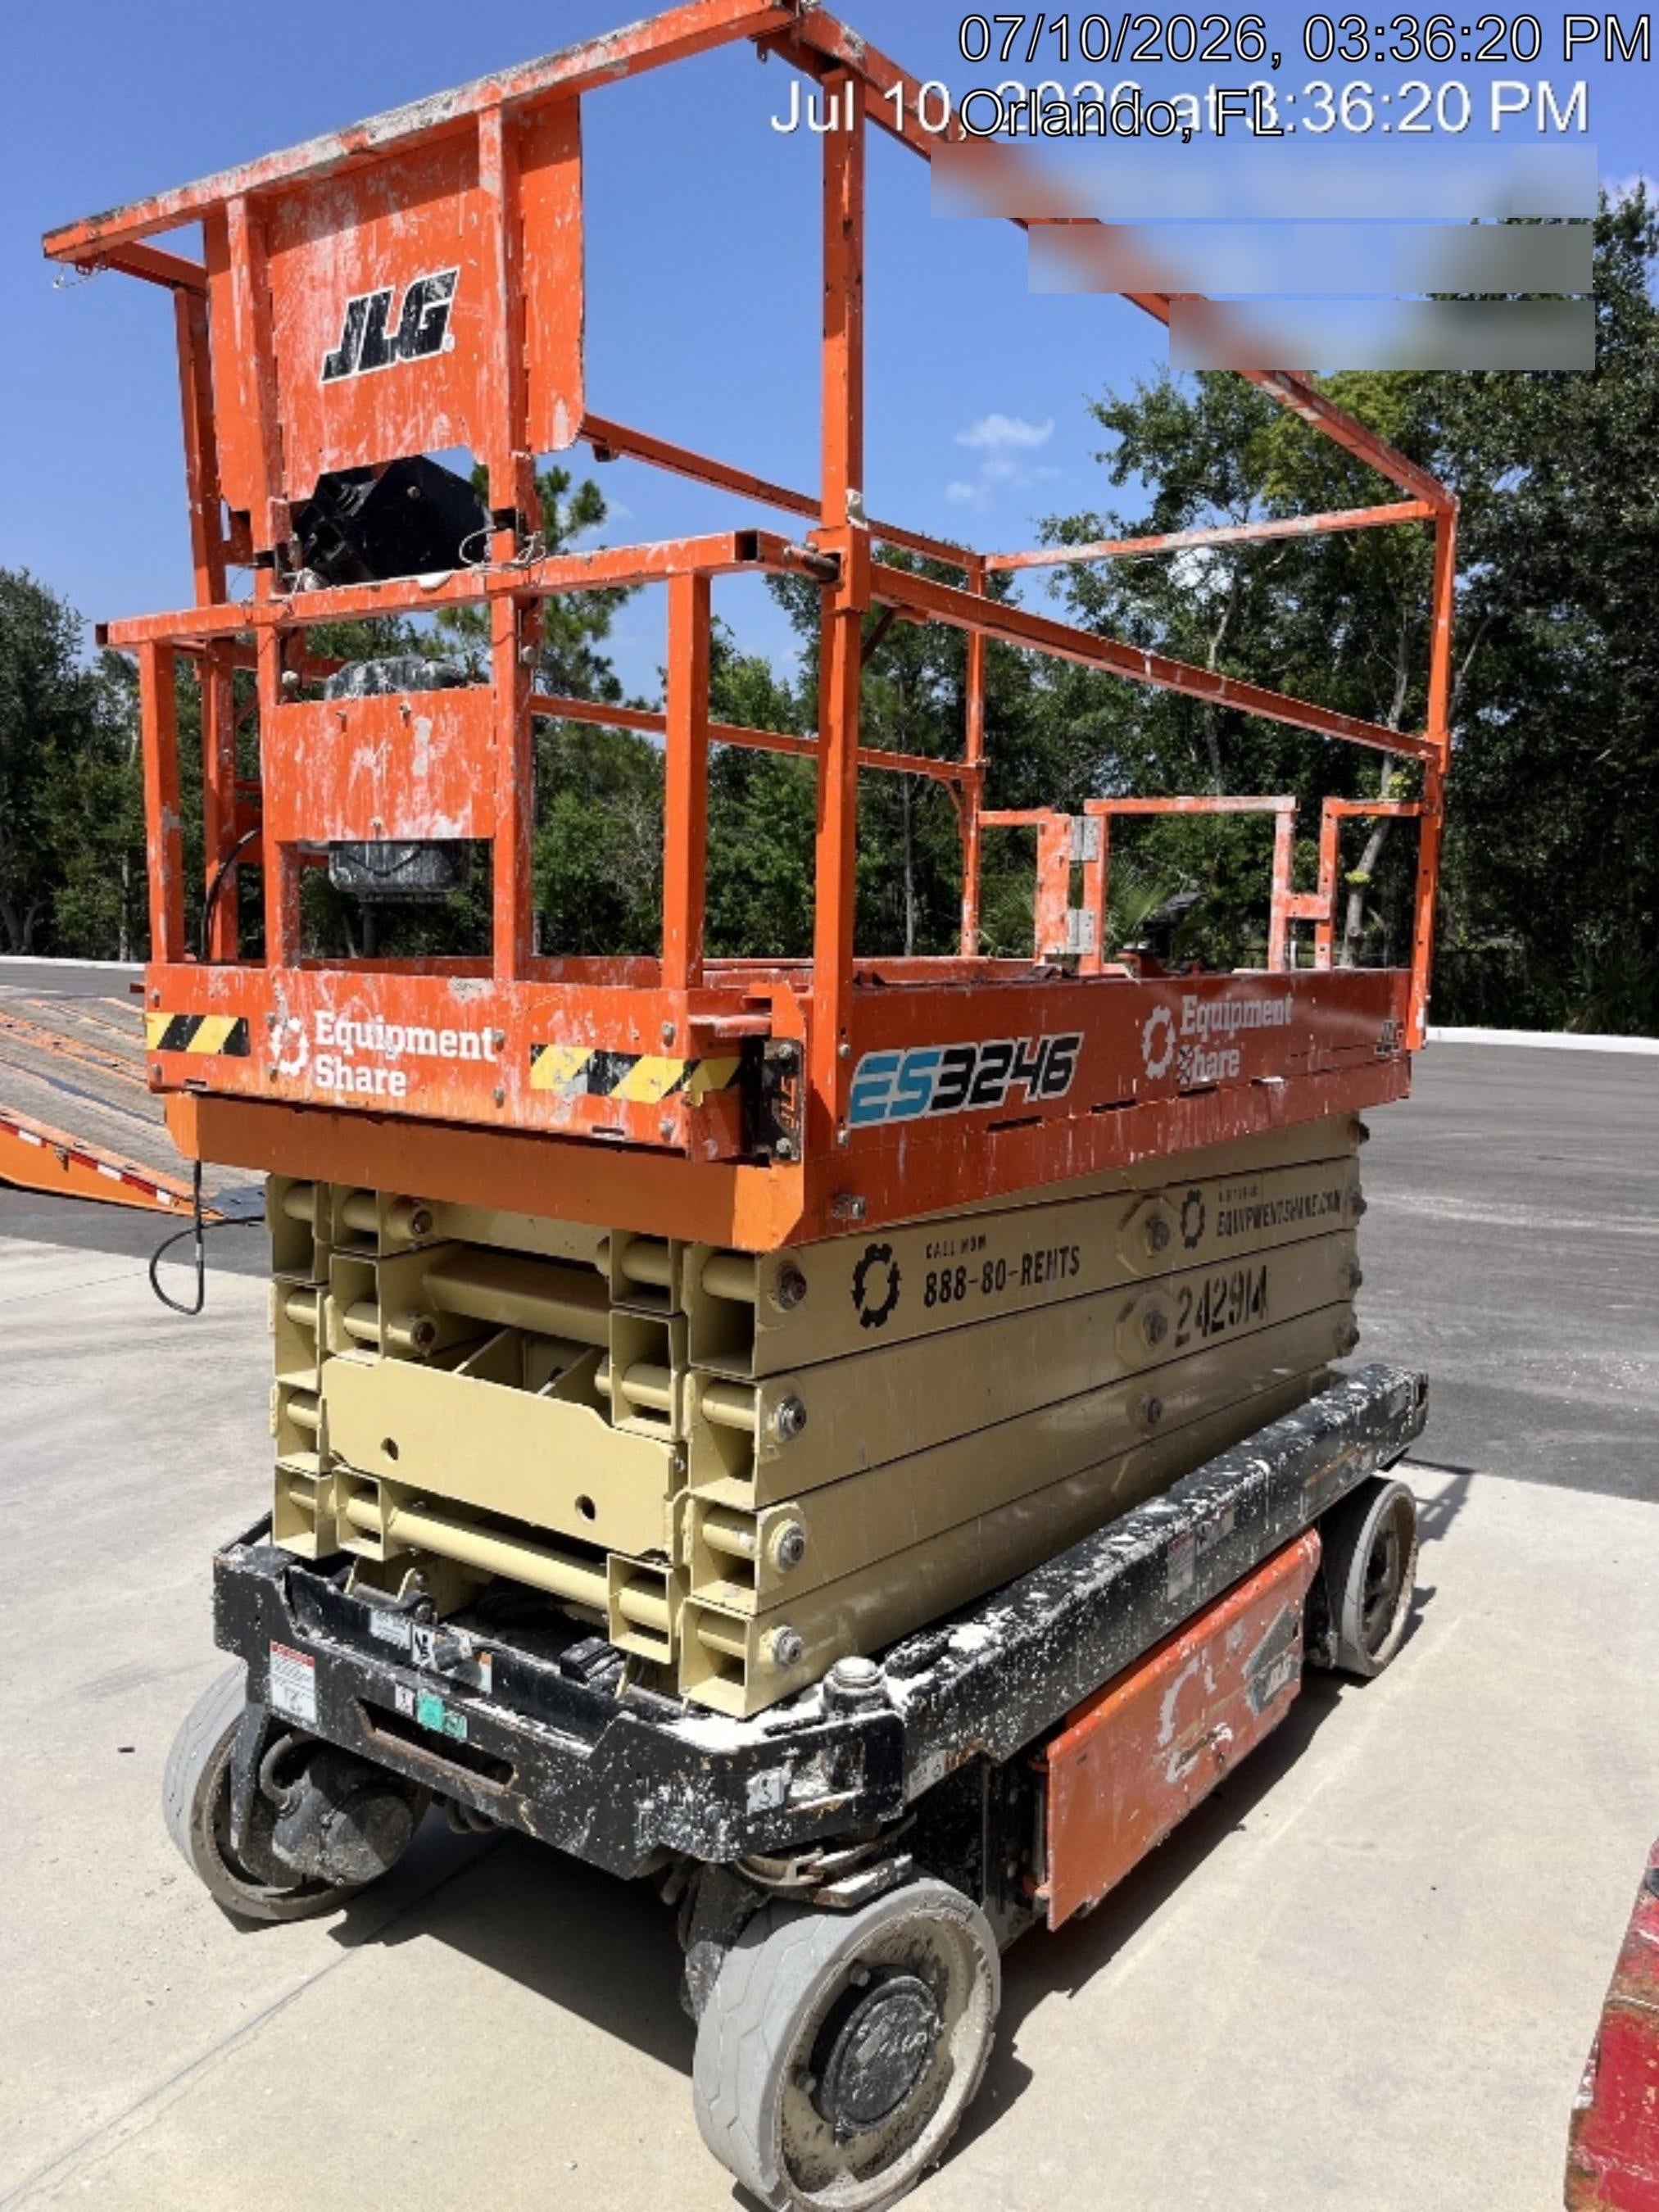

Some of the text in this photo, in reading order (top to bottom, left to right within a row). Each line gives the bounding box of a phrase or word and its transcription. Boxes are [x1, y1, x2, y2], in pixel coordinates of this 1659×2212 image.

[321, 265, 460, 384] JLG
[314, 1009, 497, 1062] Equipment
[1180, 992, 1294, 1042] Equipment
[314, 1053, 407, 1097] Share
[845, 1031, 1085, 1129] ES3246
[923, 1244, 1081, 1308] 888-80-RENTS
[925, 1240, 954, 1259] CALL
